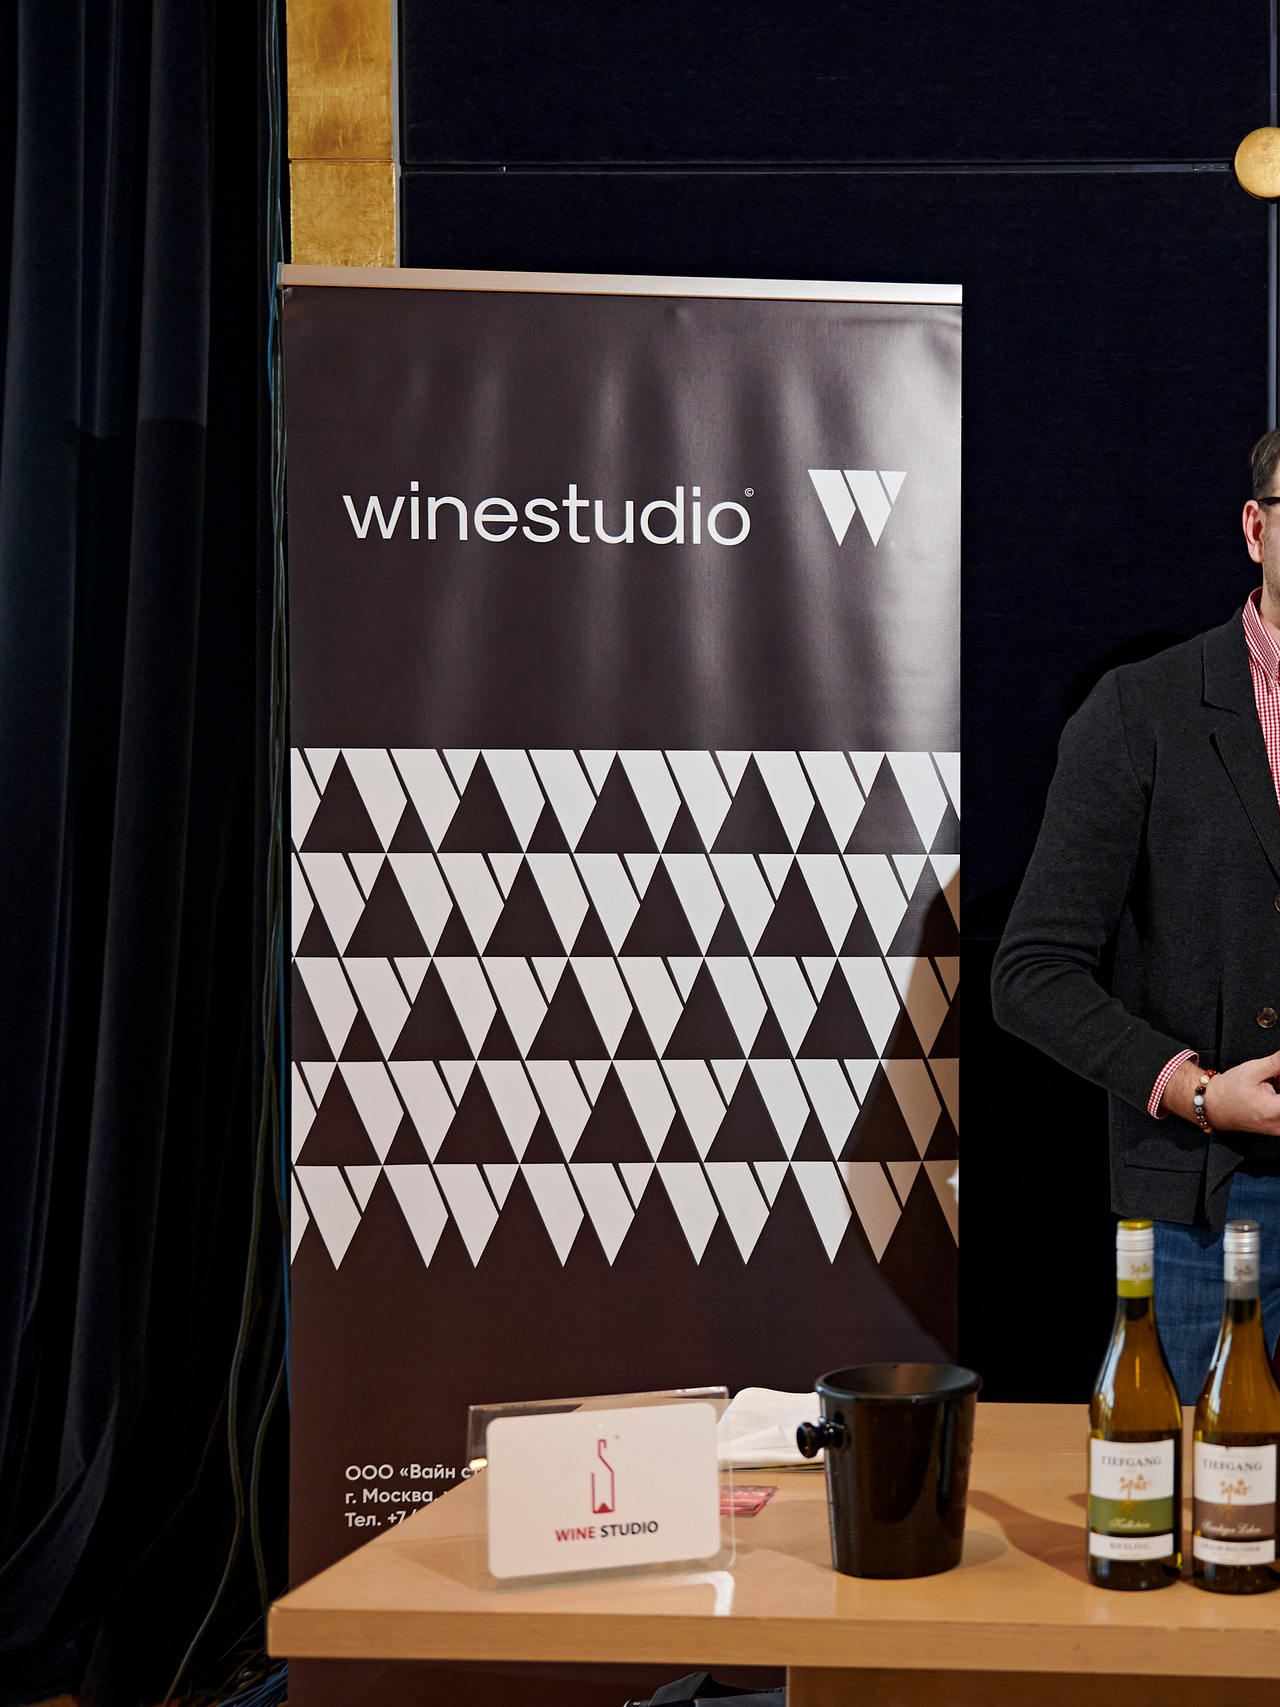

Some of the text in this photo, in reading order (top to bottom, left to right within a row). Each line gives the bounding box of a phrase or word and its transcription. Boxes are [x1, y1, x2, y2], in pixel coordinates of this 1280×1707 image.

[1100, 1455, 1162, 1467] TIEFGANG
[1202, 1458, 1263, 1471] TIEFGANG
[345, 1464, 394, 1481] ООО
[399, 1463, 456, 1480] «Вайн
[345, 1492, 357, 1505] г.
[344, 1512, 382, 1528] Тел.
[555, 1520, 659, 1542] WINE STUDIO
